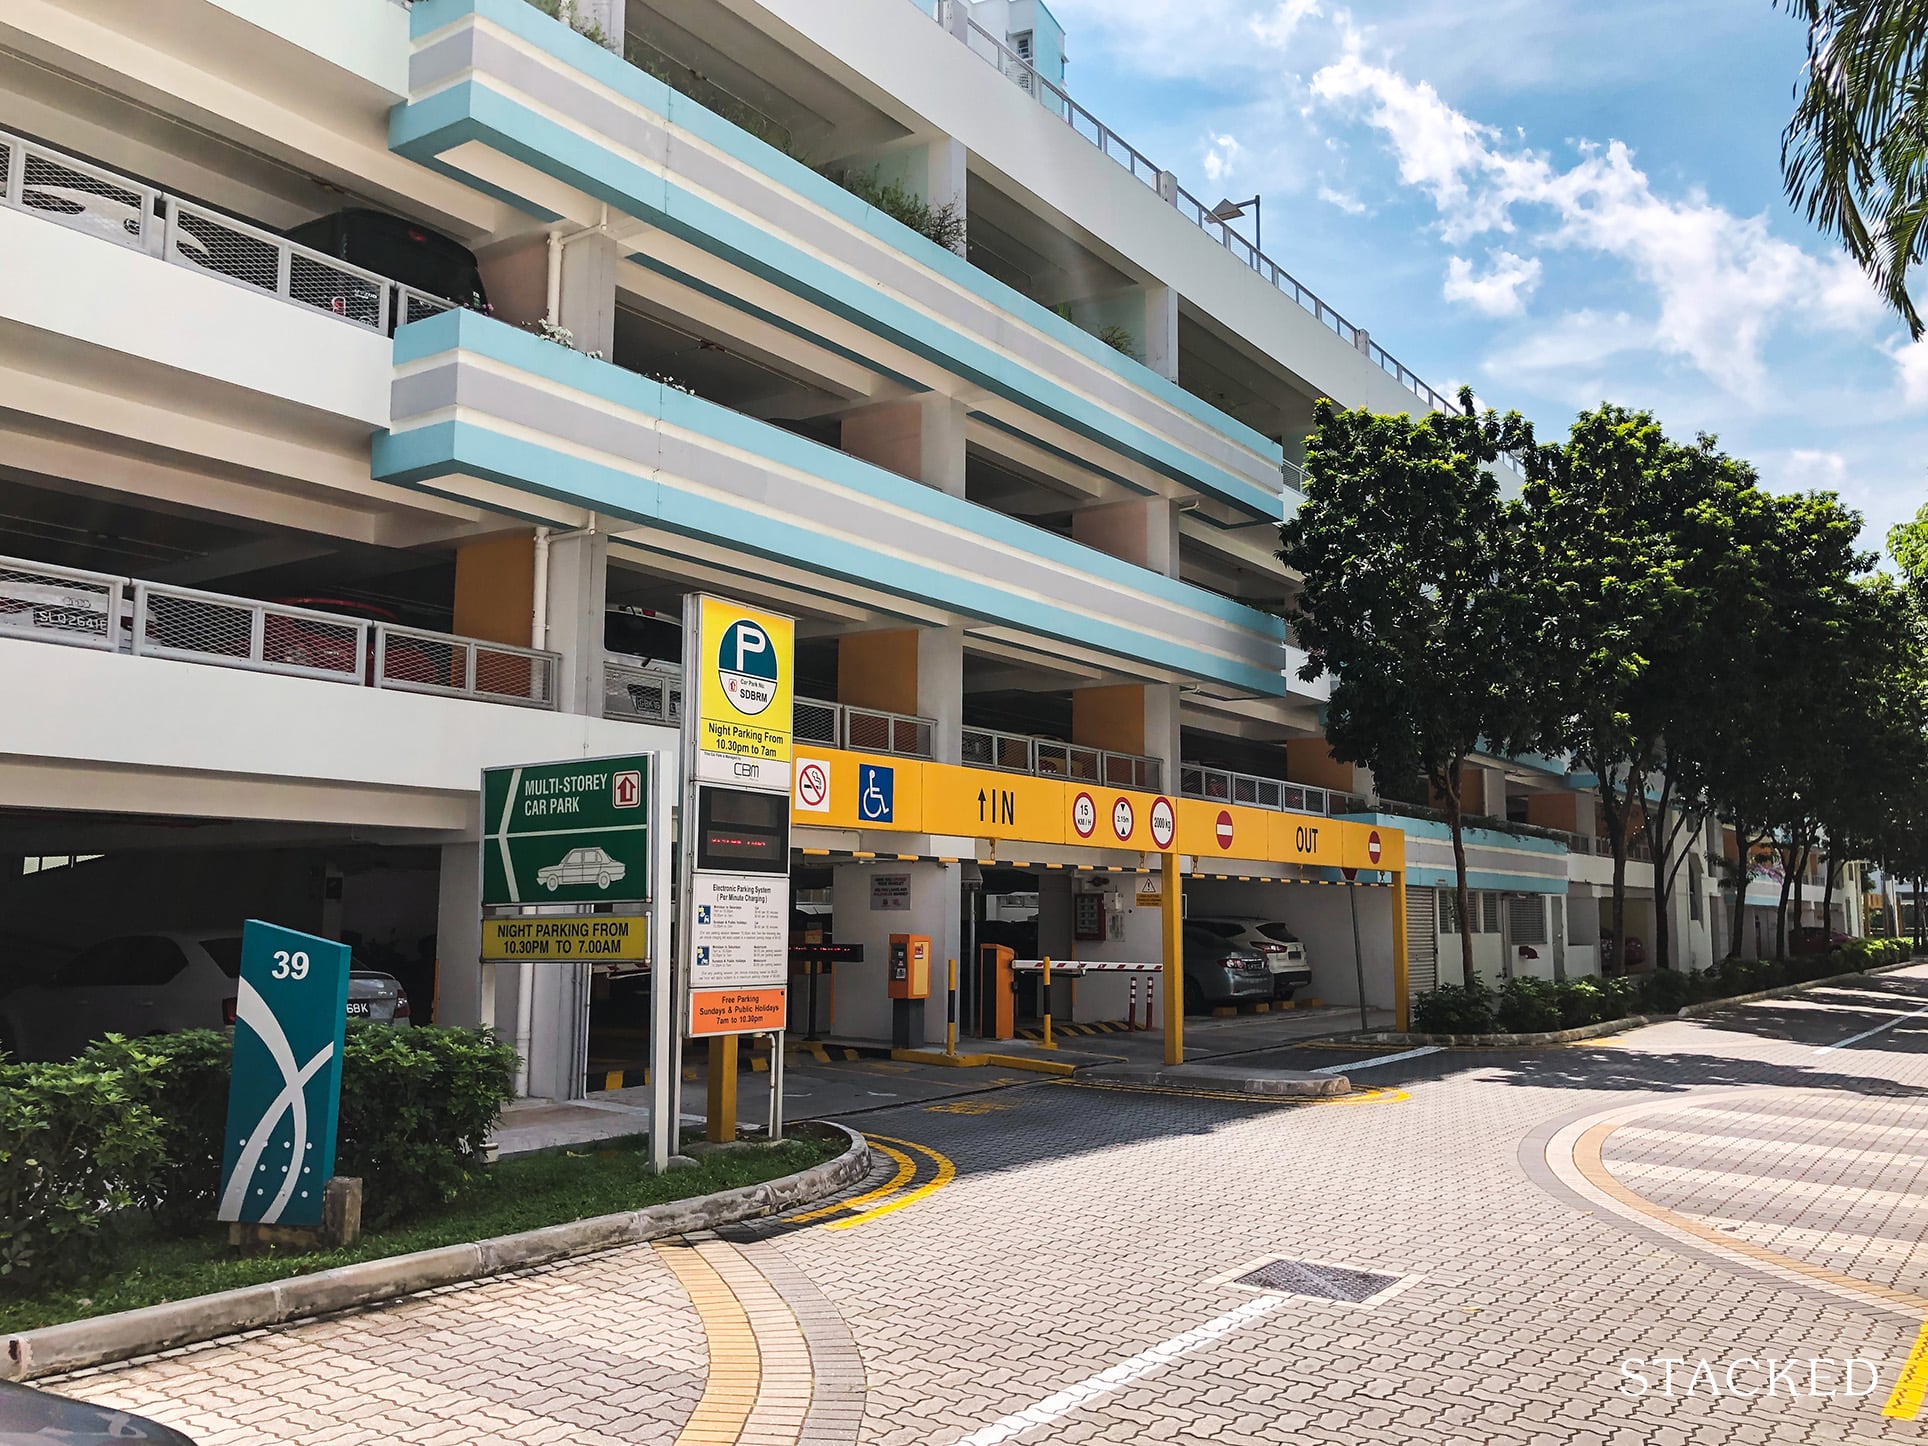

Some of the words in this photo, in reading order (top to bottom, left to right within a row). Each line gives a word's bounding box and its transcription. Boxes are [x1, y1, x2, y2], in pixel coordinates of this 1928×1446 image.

[736, 624, 766, 672] P
[740, 688, 767, 702] SDBRM
[708, 722, 730, 736] Night
[733, 726, 762, 743] Parking
[764, 732, 784, 744] From
[716, 739, 750, 753] 10.30pm
[752, 744, 759, 754] to
[762, 746, 776, 757] 7am
[525, 774, 608, 796] MULTI-STOREY
[524, 798, 547, 816] CAR
[550, 796, 580, 814] PARK
[992, 788, 1014, 825] IN
[1080, 804, 1088, 816] 15
[1154, 817, 1164, 828] 2000
[1165, 818, 1171, 832] kg
[1296, 826, 1318, 853] OUT
[713, 884, 736, 892] Electronic
[737, 885, 754, 894] Parking
[755, 886, 772, 894] System
[498, 924, 533, 938] NIGHT
[536, 923, 589, 938] PARKING
[592, 922, 629, 937] FROM
[504, 940, 549, 954] 10.30PM
[556, 940, 572, 954] TO
[578, 940, 621, 954] 7.00AM
[272, 950, 310, 980] 39
[737, 995, 759, 1003] Parking
[699, 1007, 726, 1016] Sundays
[740, 1015, 763, 1023] 10.30pm
